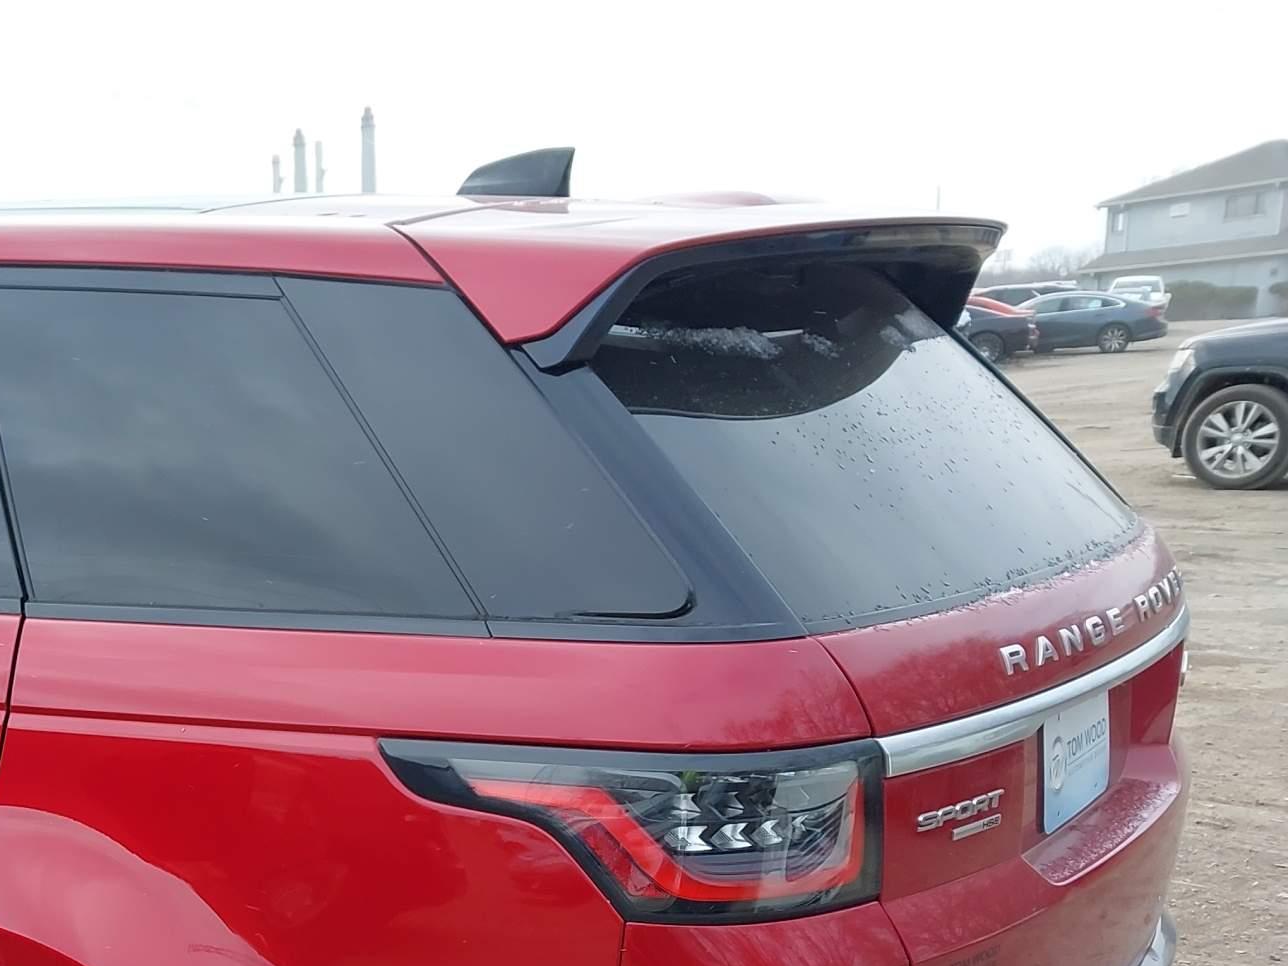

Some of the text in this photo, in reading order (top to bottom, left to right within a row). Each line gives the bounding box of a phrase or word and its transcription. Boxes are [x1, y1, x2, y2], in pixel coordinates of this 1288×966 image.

[999, 606, 1126, 676] RANGE
[1066, 717, 1107, 760] TOM WOOD
[916, 788, 1005, 832] SPORT
[982, 815, 1001, 830] HSE
